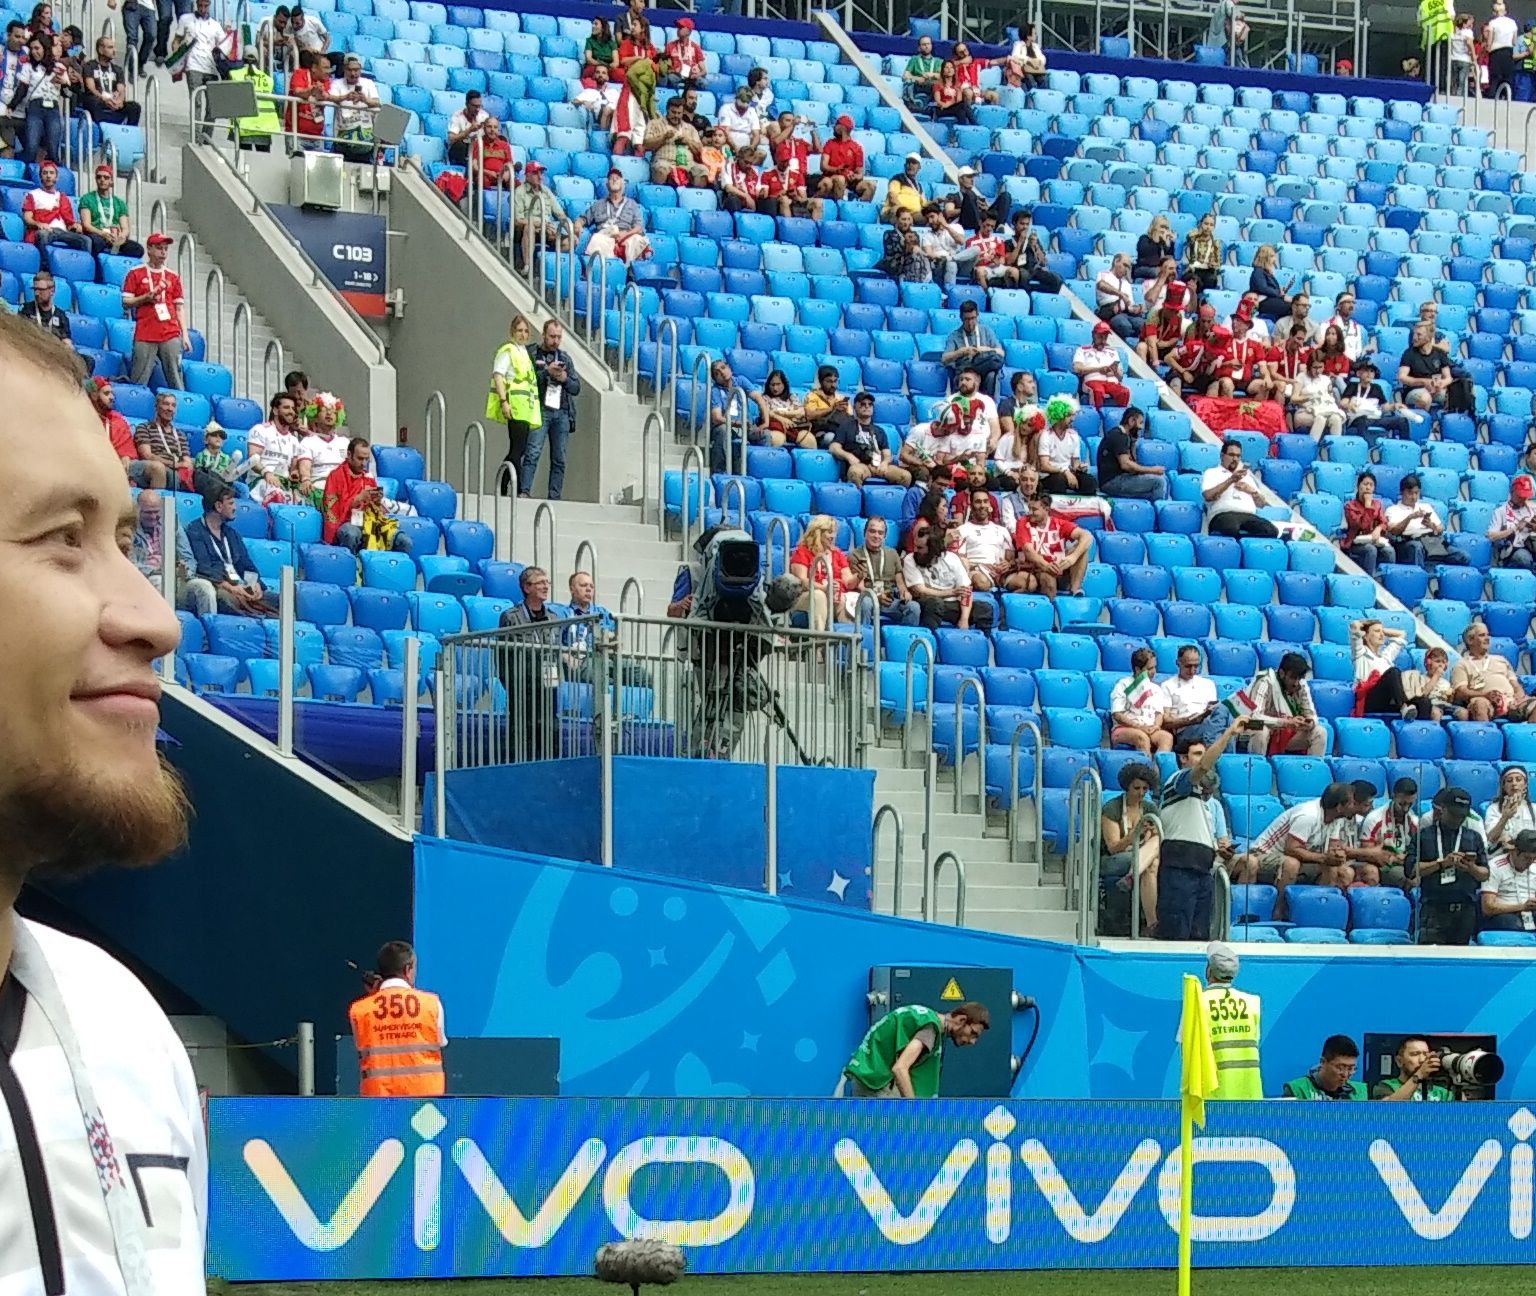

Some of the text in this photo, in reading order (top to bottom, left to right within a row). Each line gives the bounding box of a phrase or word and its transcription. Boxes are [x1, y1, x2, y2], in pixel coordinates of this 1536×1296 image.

[332, 244, 373, 263] C103
[373, 993, 421, 1020] 350
[1209, 998, 1249, 1021] 5532
[1211, 1025, 1251, 1035] STEWARD
[242, 1102, 756, 1252] vivo
[833, 1104, 1297, 1246] vivo
